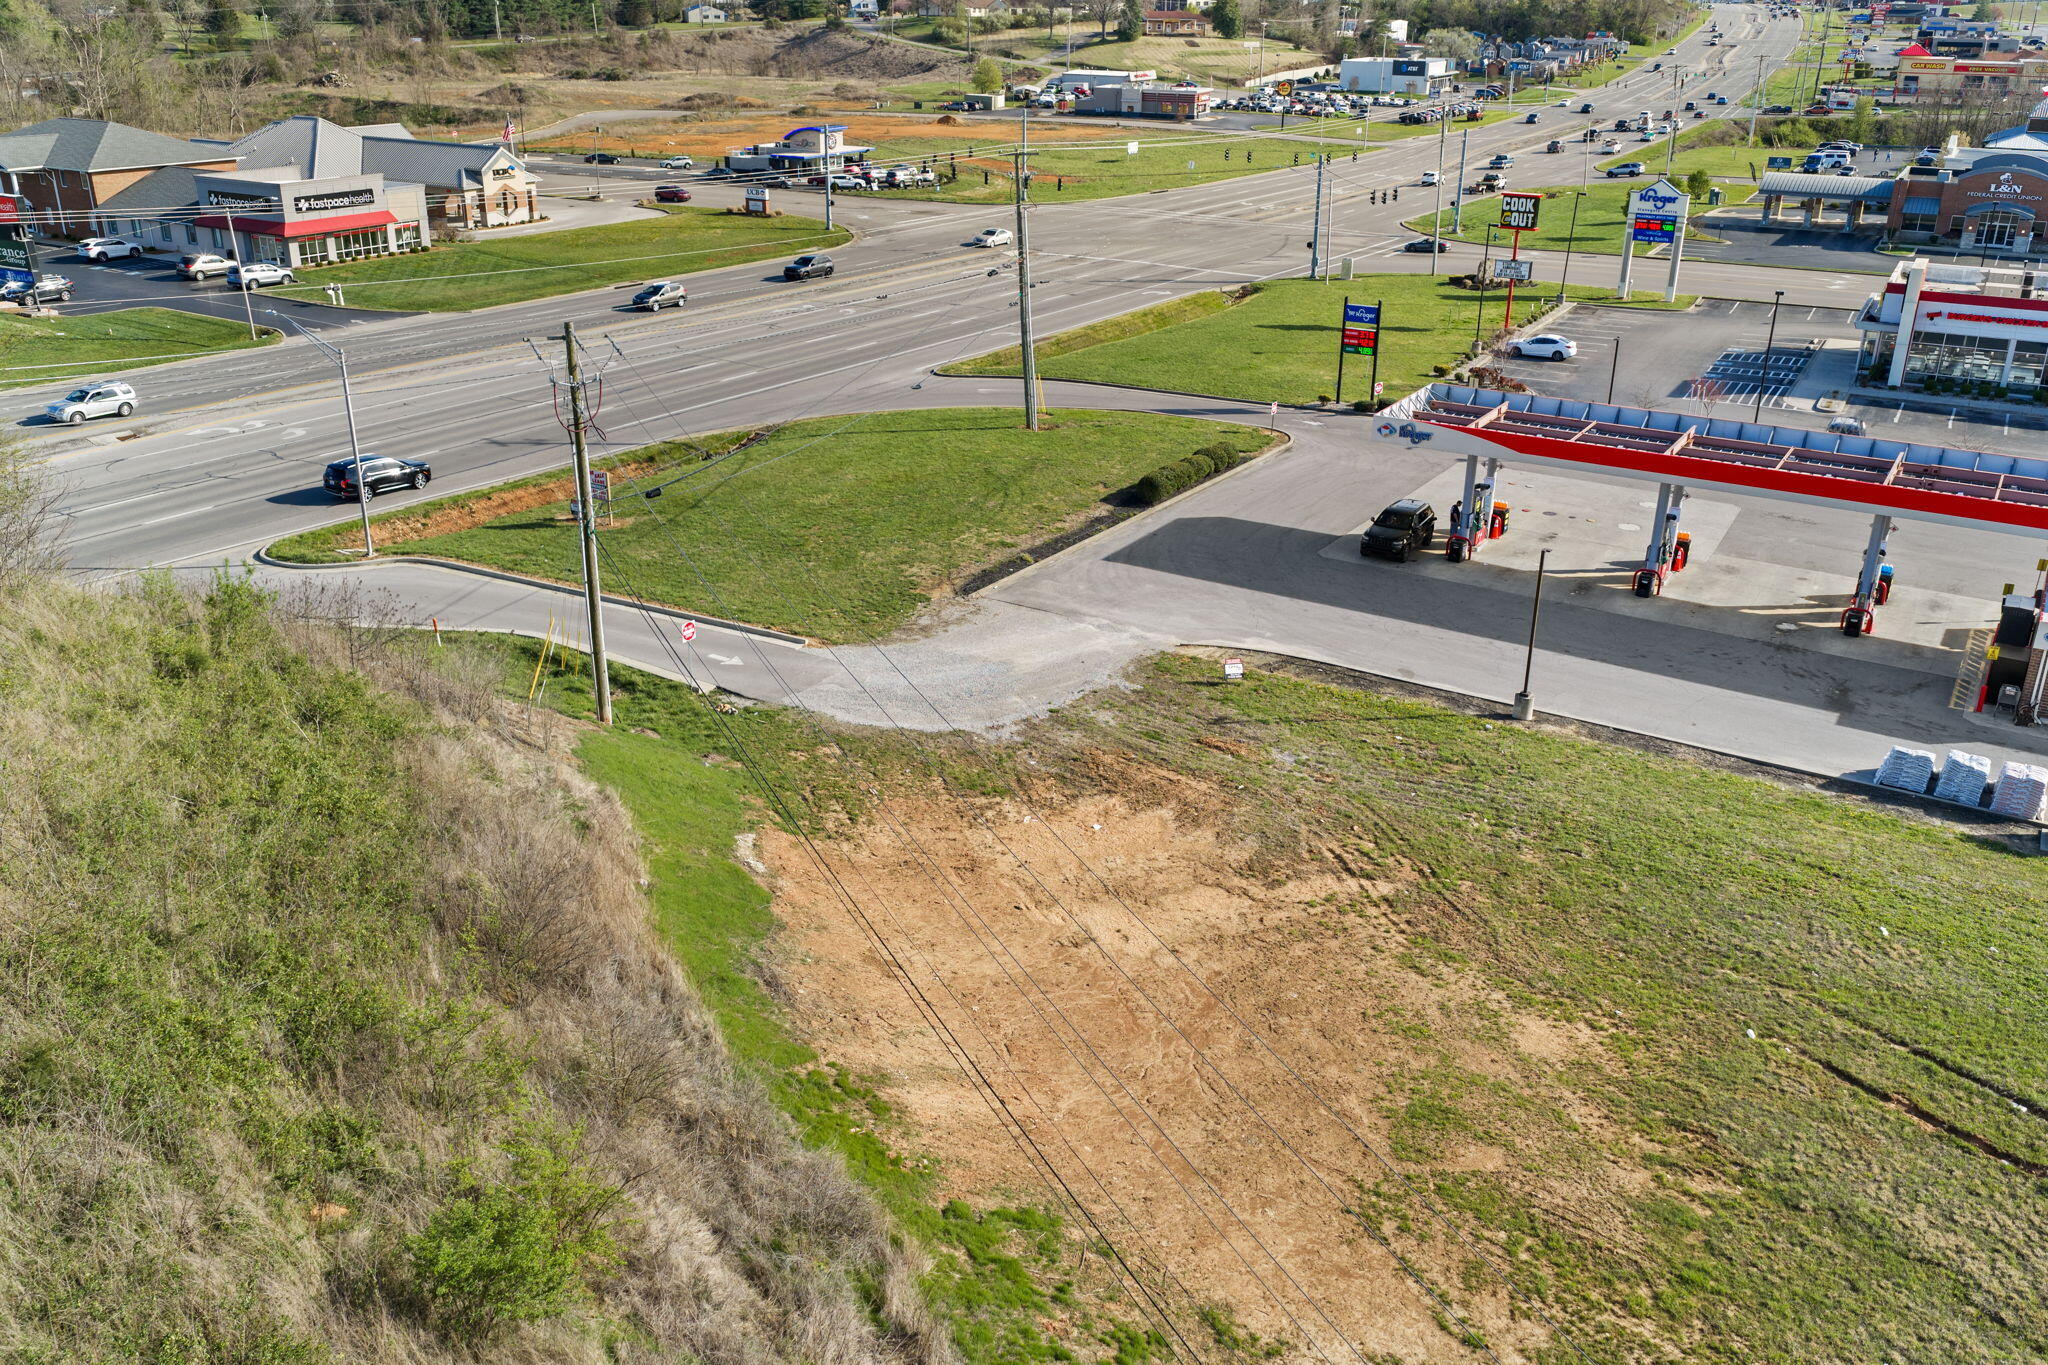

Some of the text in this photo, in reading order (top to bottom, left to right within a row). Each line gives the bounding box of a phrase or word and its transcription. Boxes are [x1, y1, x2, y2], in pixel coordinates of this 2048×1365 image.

[1990, 184, 2022, 193] L&N
[1502, 196, 1535, 213] COOK
[1640, 188, 1678, 209] Kroger
[1510, 213, 1534, 227] OUT
[6, 255, 27, 267] Group
[1355, 308, 1376, 322] Kroger
[1399, 422, 1434, 445] Kroger
